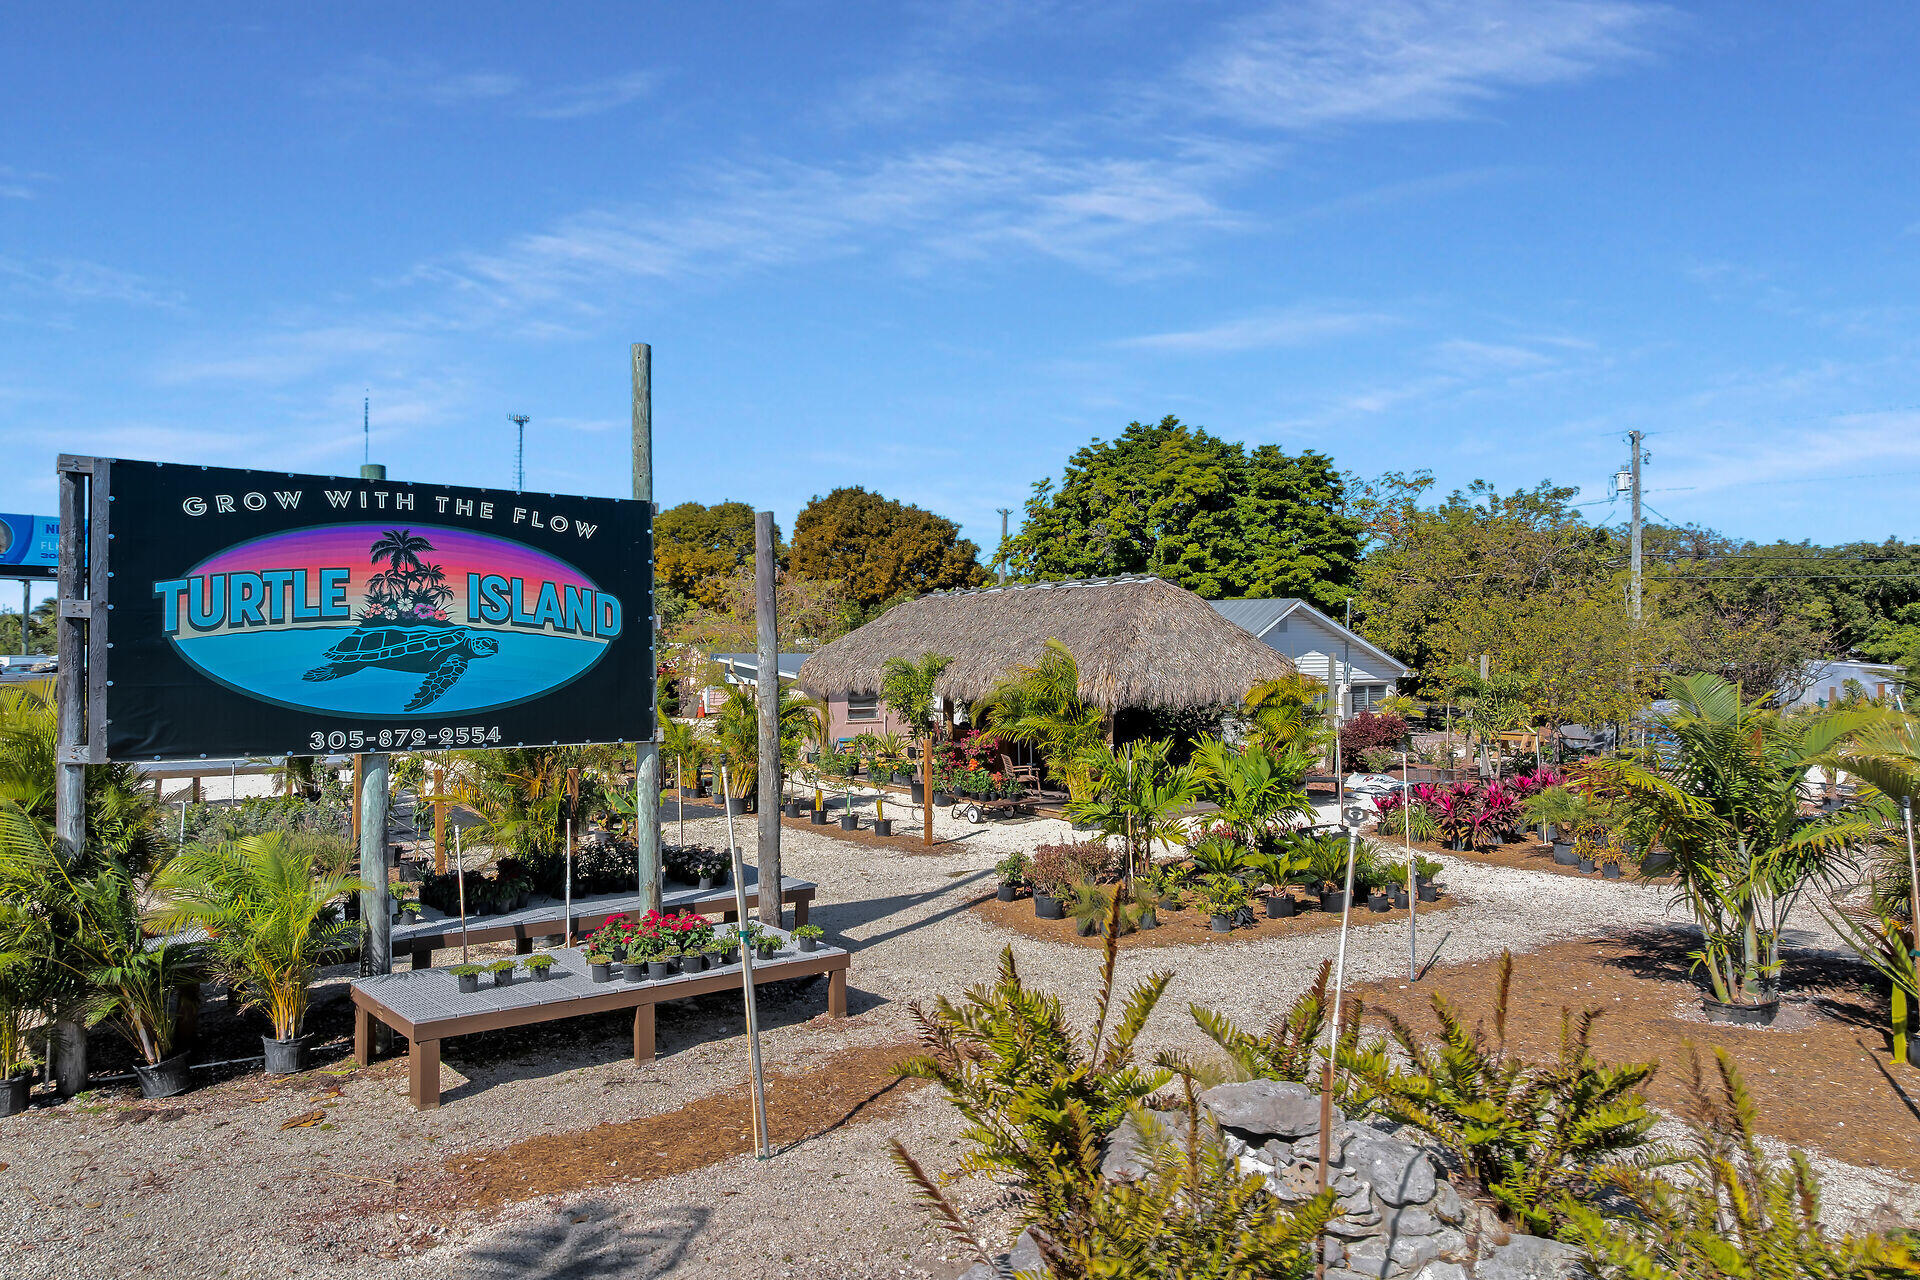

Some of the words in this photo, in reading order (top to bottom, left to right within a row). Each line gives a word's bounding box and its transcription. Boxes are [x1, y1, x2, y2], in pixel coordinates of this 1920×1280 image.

[182, 490, 303, 516] GROW
[324, 490, 414, 510] WITH
[435, 495, 494, 520] THE
[512, 506, 598, 540] FLOW
[153, 567, 351, 636] TURTLE
[467, 572, 623, 640] ISLAND
[309, 726, 502, 750] 305-872-2554
